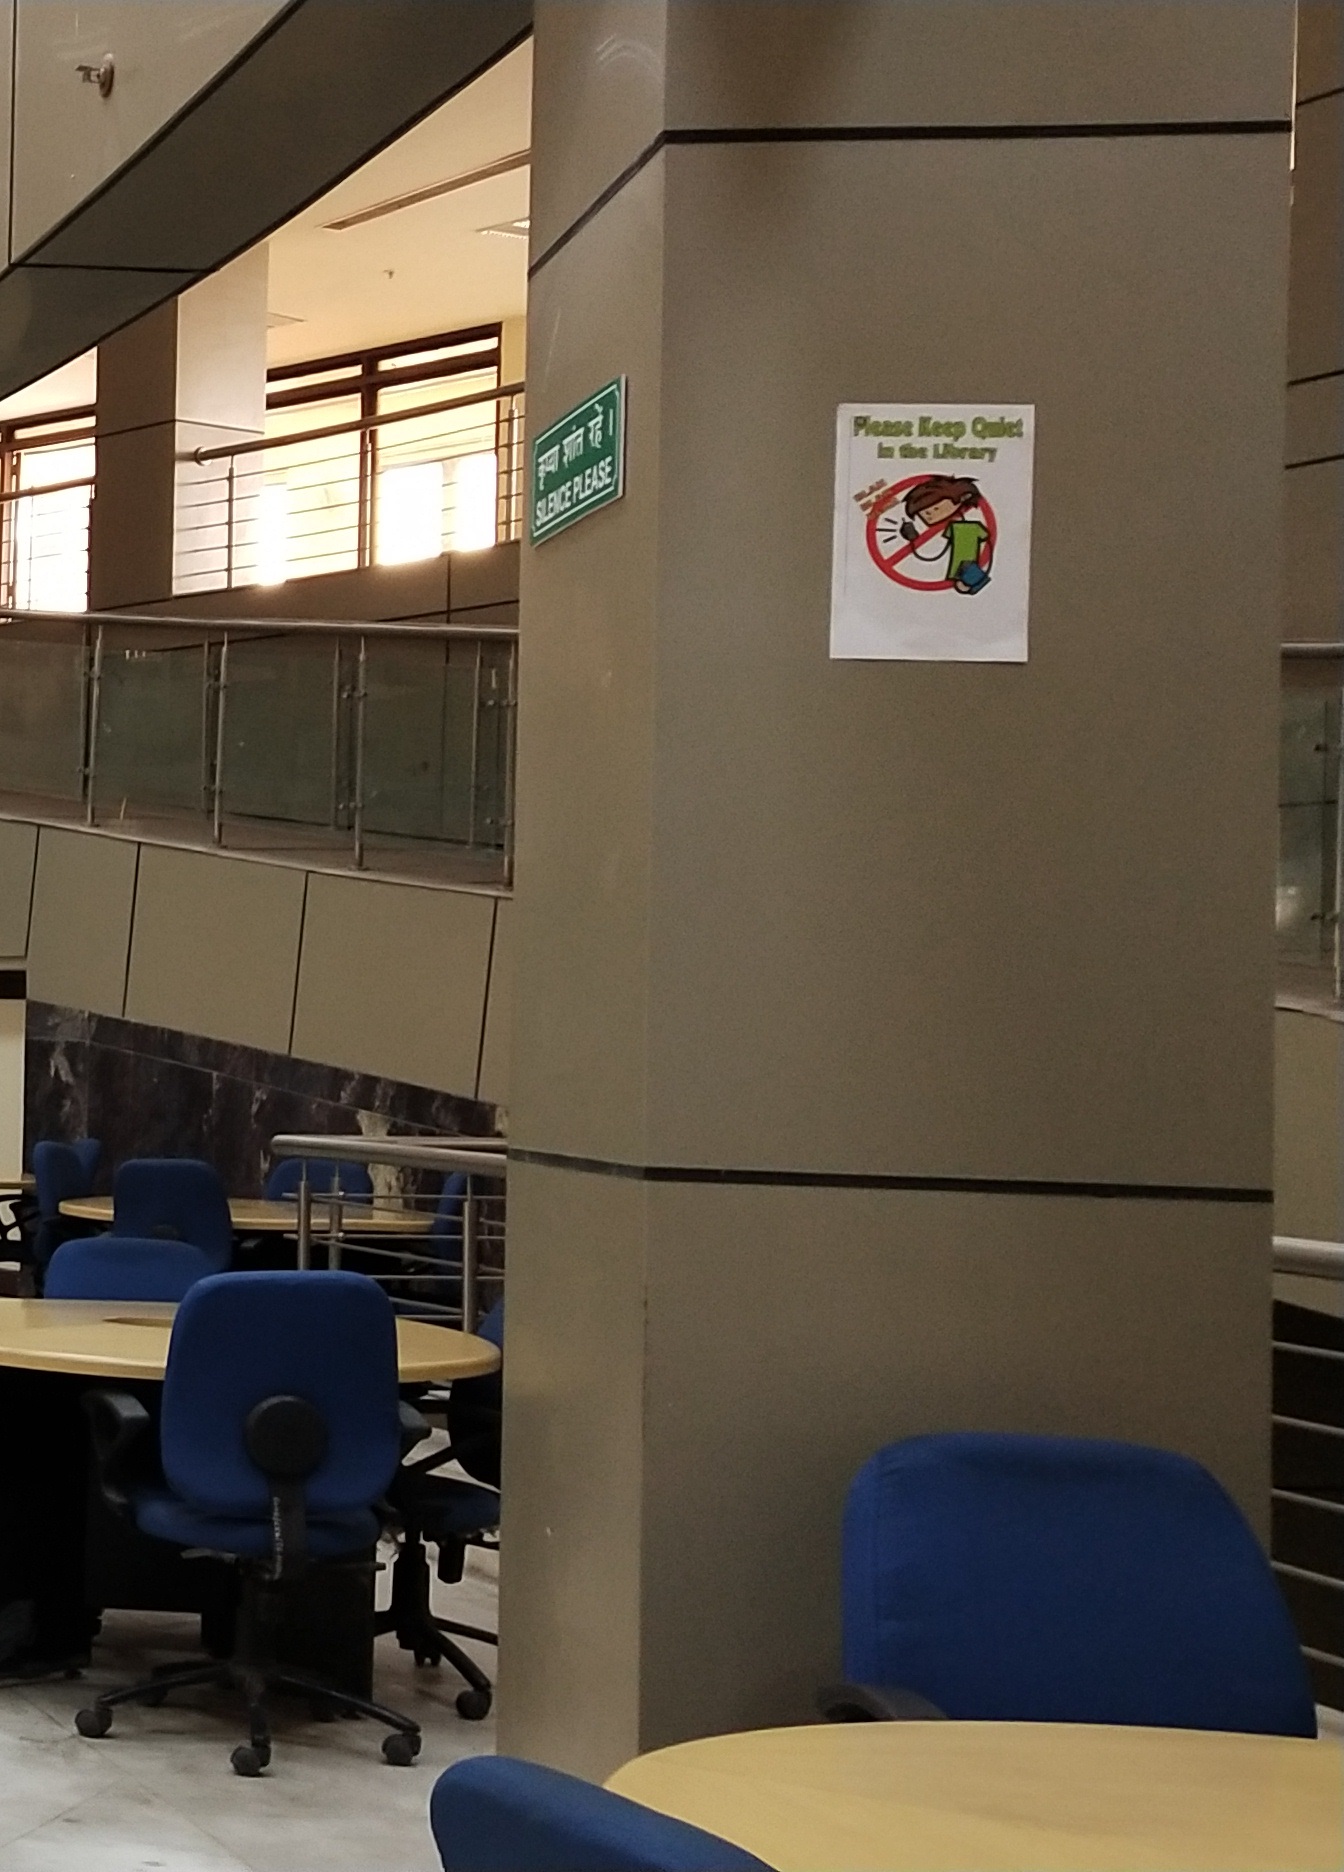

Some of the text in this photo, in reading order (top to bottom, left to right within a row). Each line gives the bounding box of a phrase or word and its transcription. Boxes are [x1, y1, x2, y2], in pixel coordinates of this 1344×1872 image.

[853, 415, 1024, 443] Please Keep Quiet
[899, 442, 928, 459] the
[933, 442, 998, 463] Library
[536, 455, 613, 528] SILENCE PLEASE
